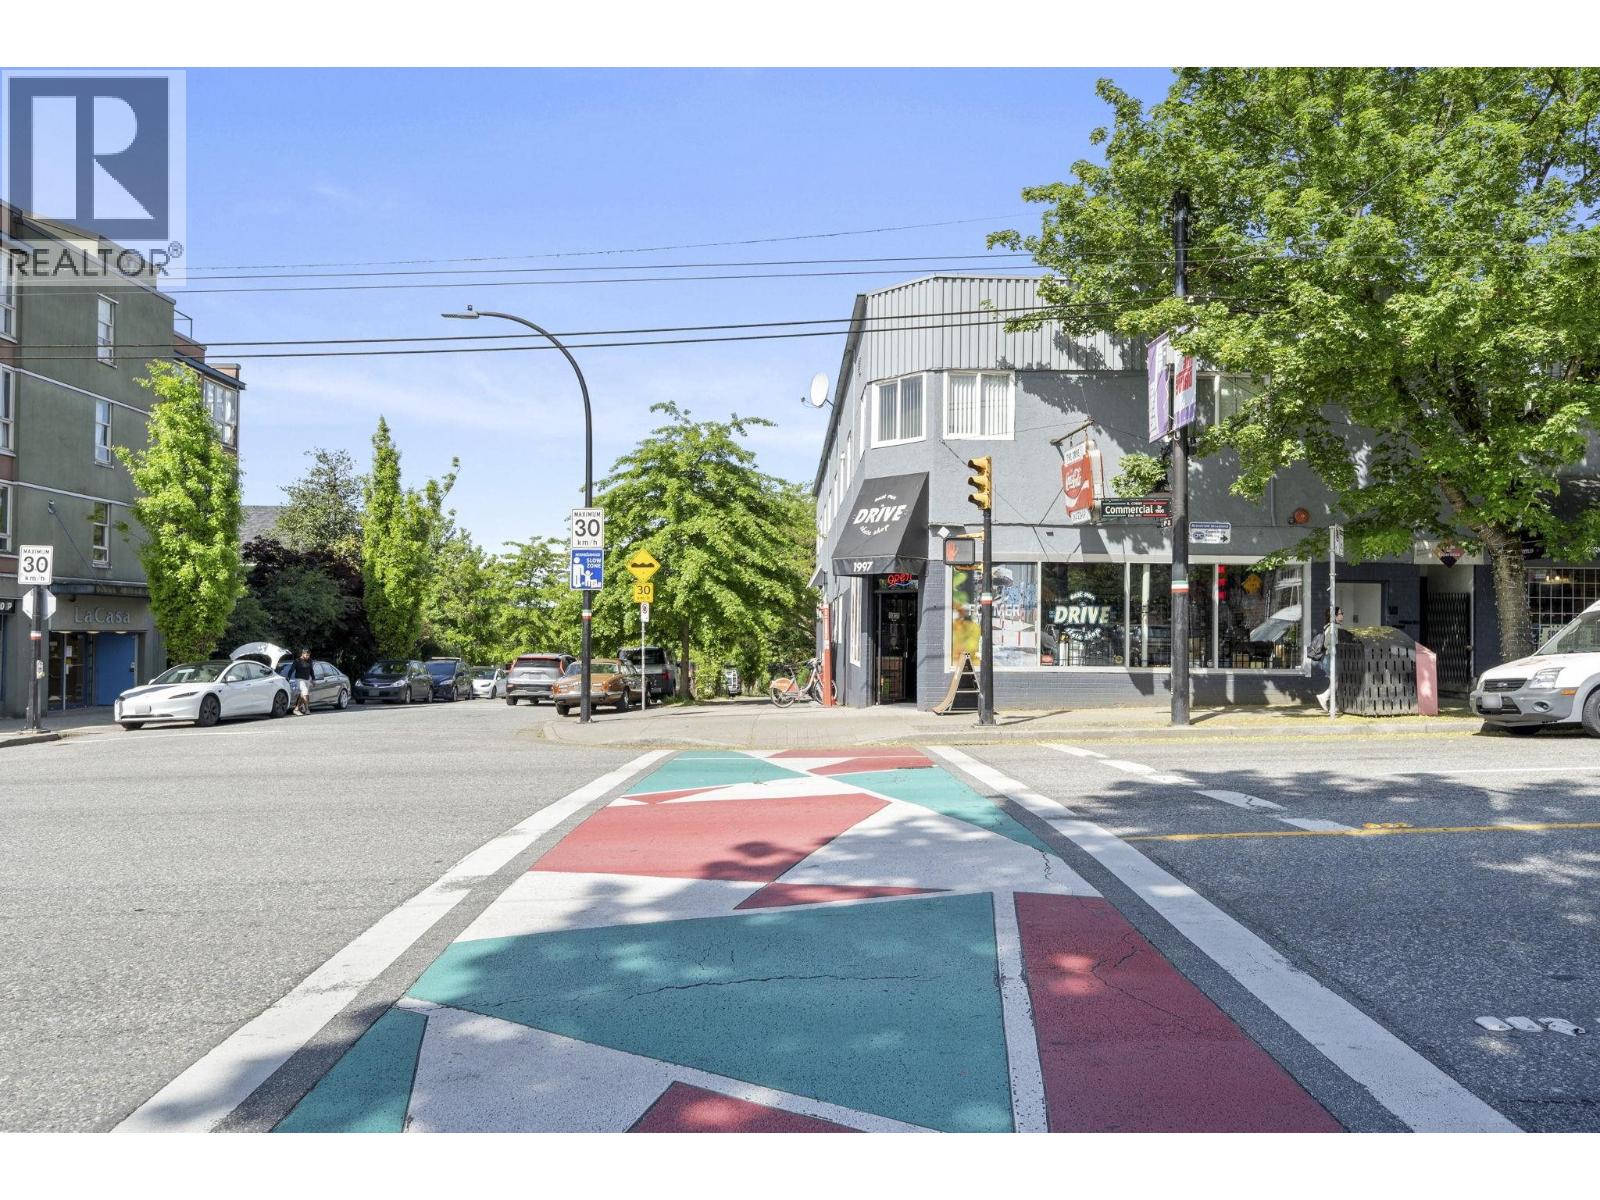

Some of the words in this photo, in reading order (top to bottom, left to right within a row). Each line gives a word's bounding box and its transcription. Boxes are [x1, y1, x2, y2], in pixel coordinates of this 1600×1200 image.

[853, 504, 907, 524] DRIVE
[1104, 504, 1154, 514] Commercial
[575, 519, 600, 537] 30
[23, 556, 48, 573] 30
[853, 561, 874, 572] 1997
[637, 586, 651, 594] 30
[1054, 606, 1110, 623] DRIVE
